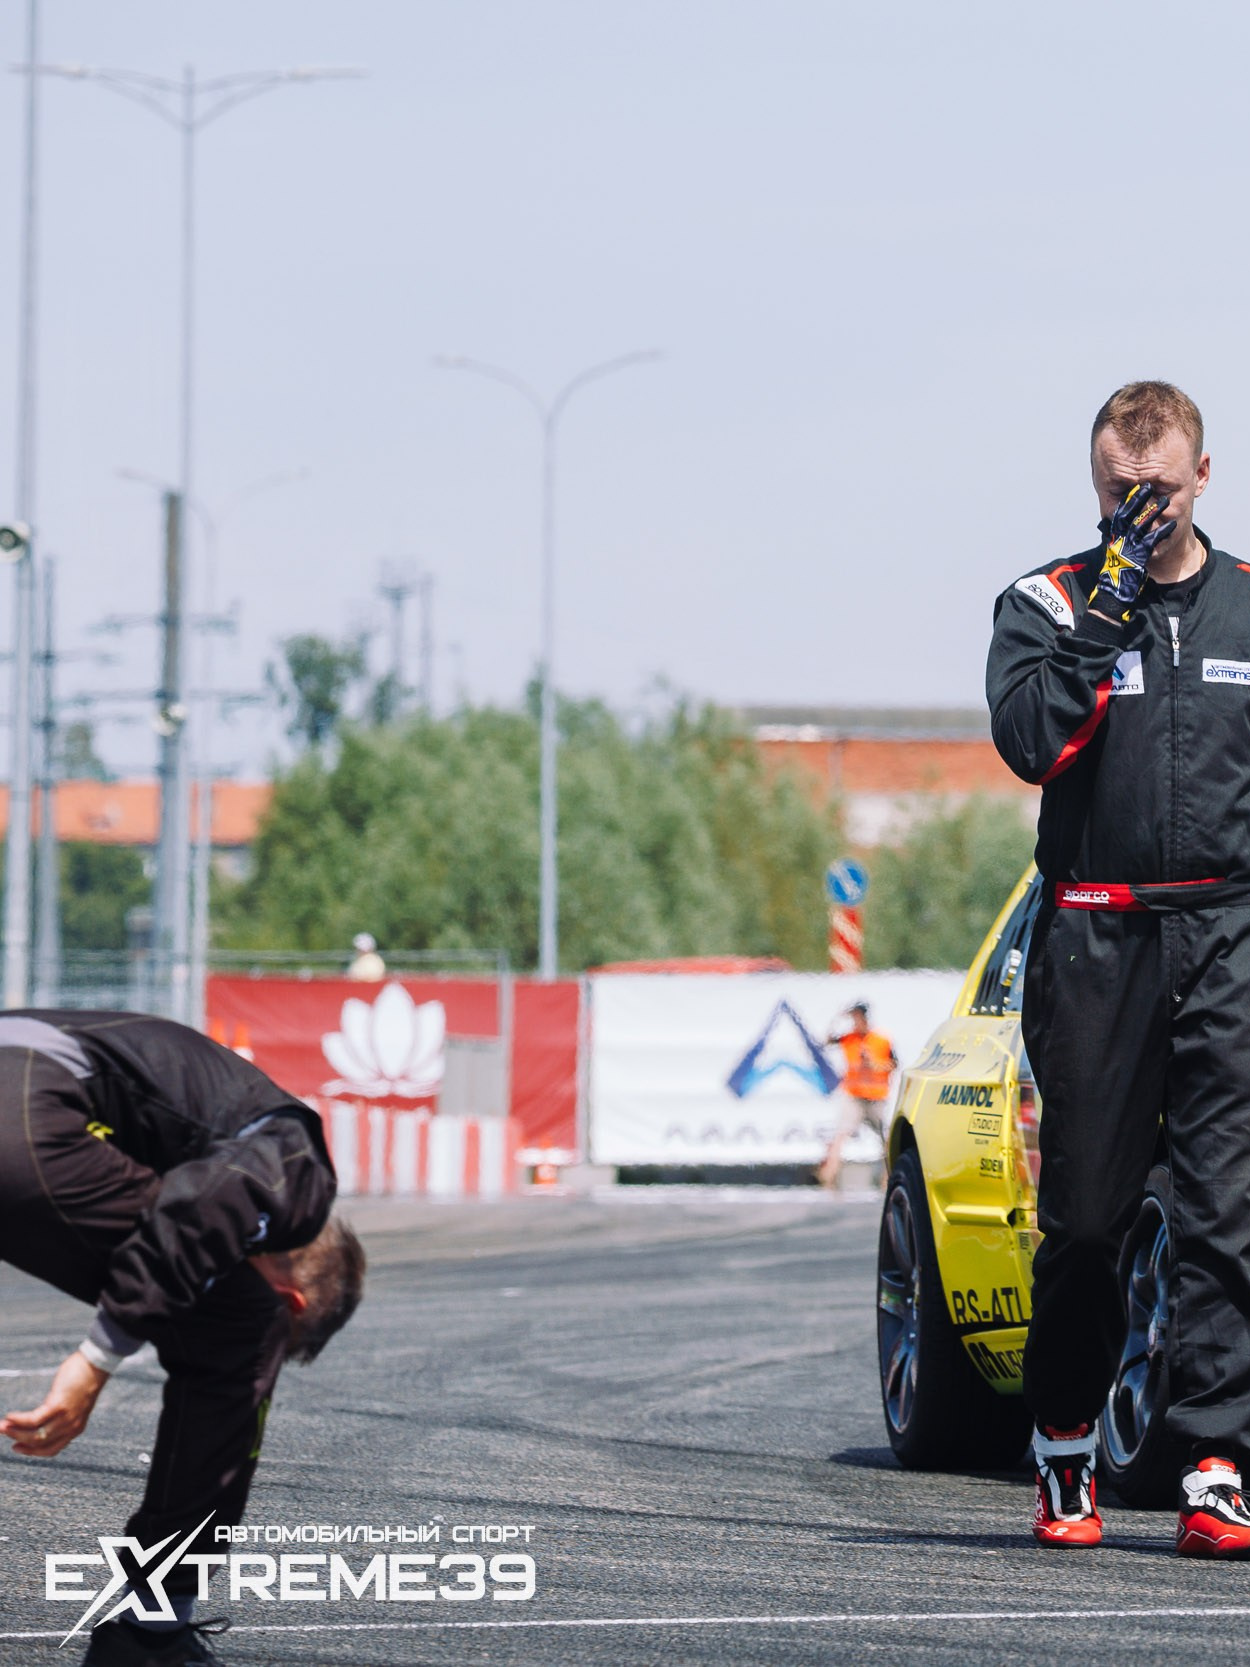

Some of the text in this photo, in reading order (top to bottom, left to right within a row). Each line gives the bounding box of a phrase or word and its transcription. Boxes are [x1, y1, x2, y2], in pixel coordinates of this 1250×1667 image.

[1027, 583, 1064, 614] sparco
[1063, 889, 1110, 903] sparco
[937, 1084, 994, 1108] MANNOL
